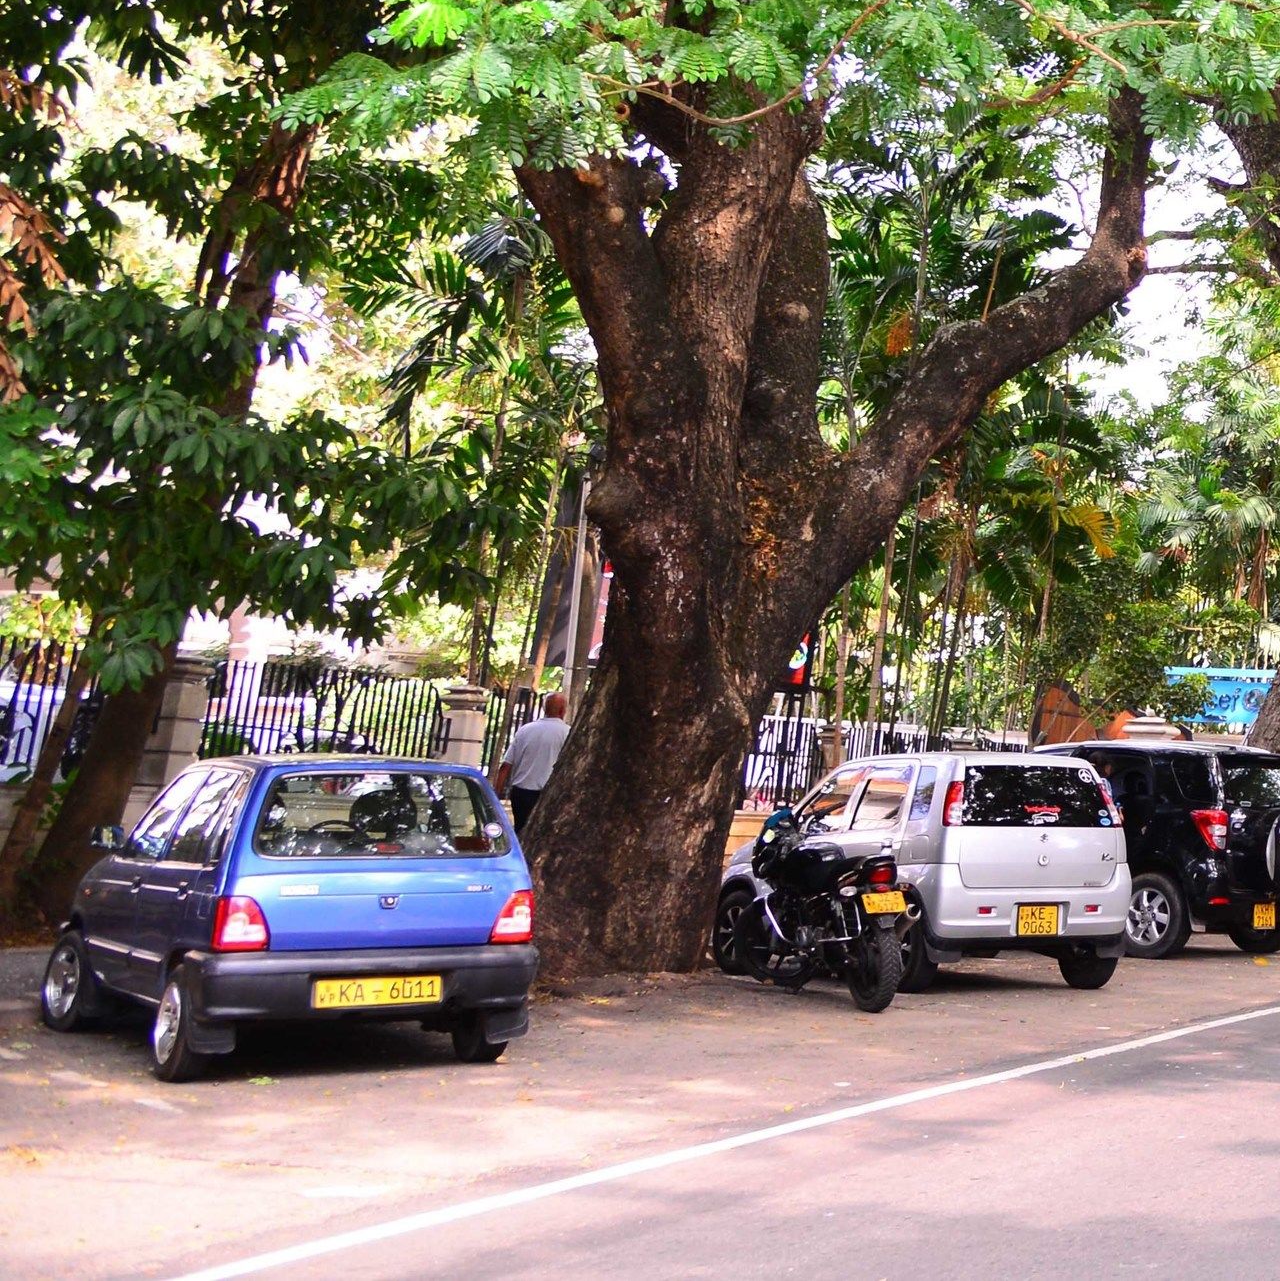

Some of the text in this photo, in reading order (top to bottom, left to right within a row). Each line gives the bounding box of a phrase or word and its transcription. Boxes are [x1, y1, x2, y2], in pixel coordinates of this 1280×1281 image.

[1030, 907, 1046, 920] KE
[1023, 921, 1053, 934] 9063
[338, 982, 366, 1002] KA
[389, 979, 438, 1000] 6011
